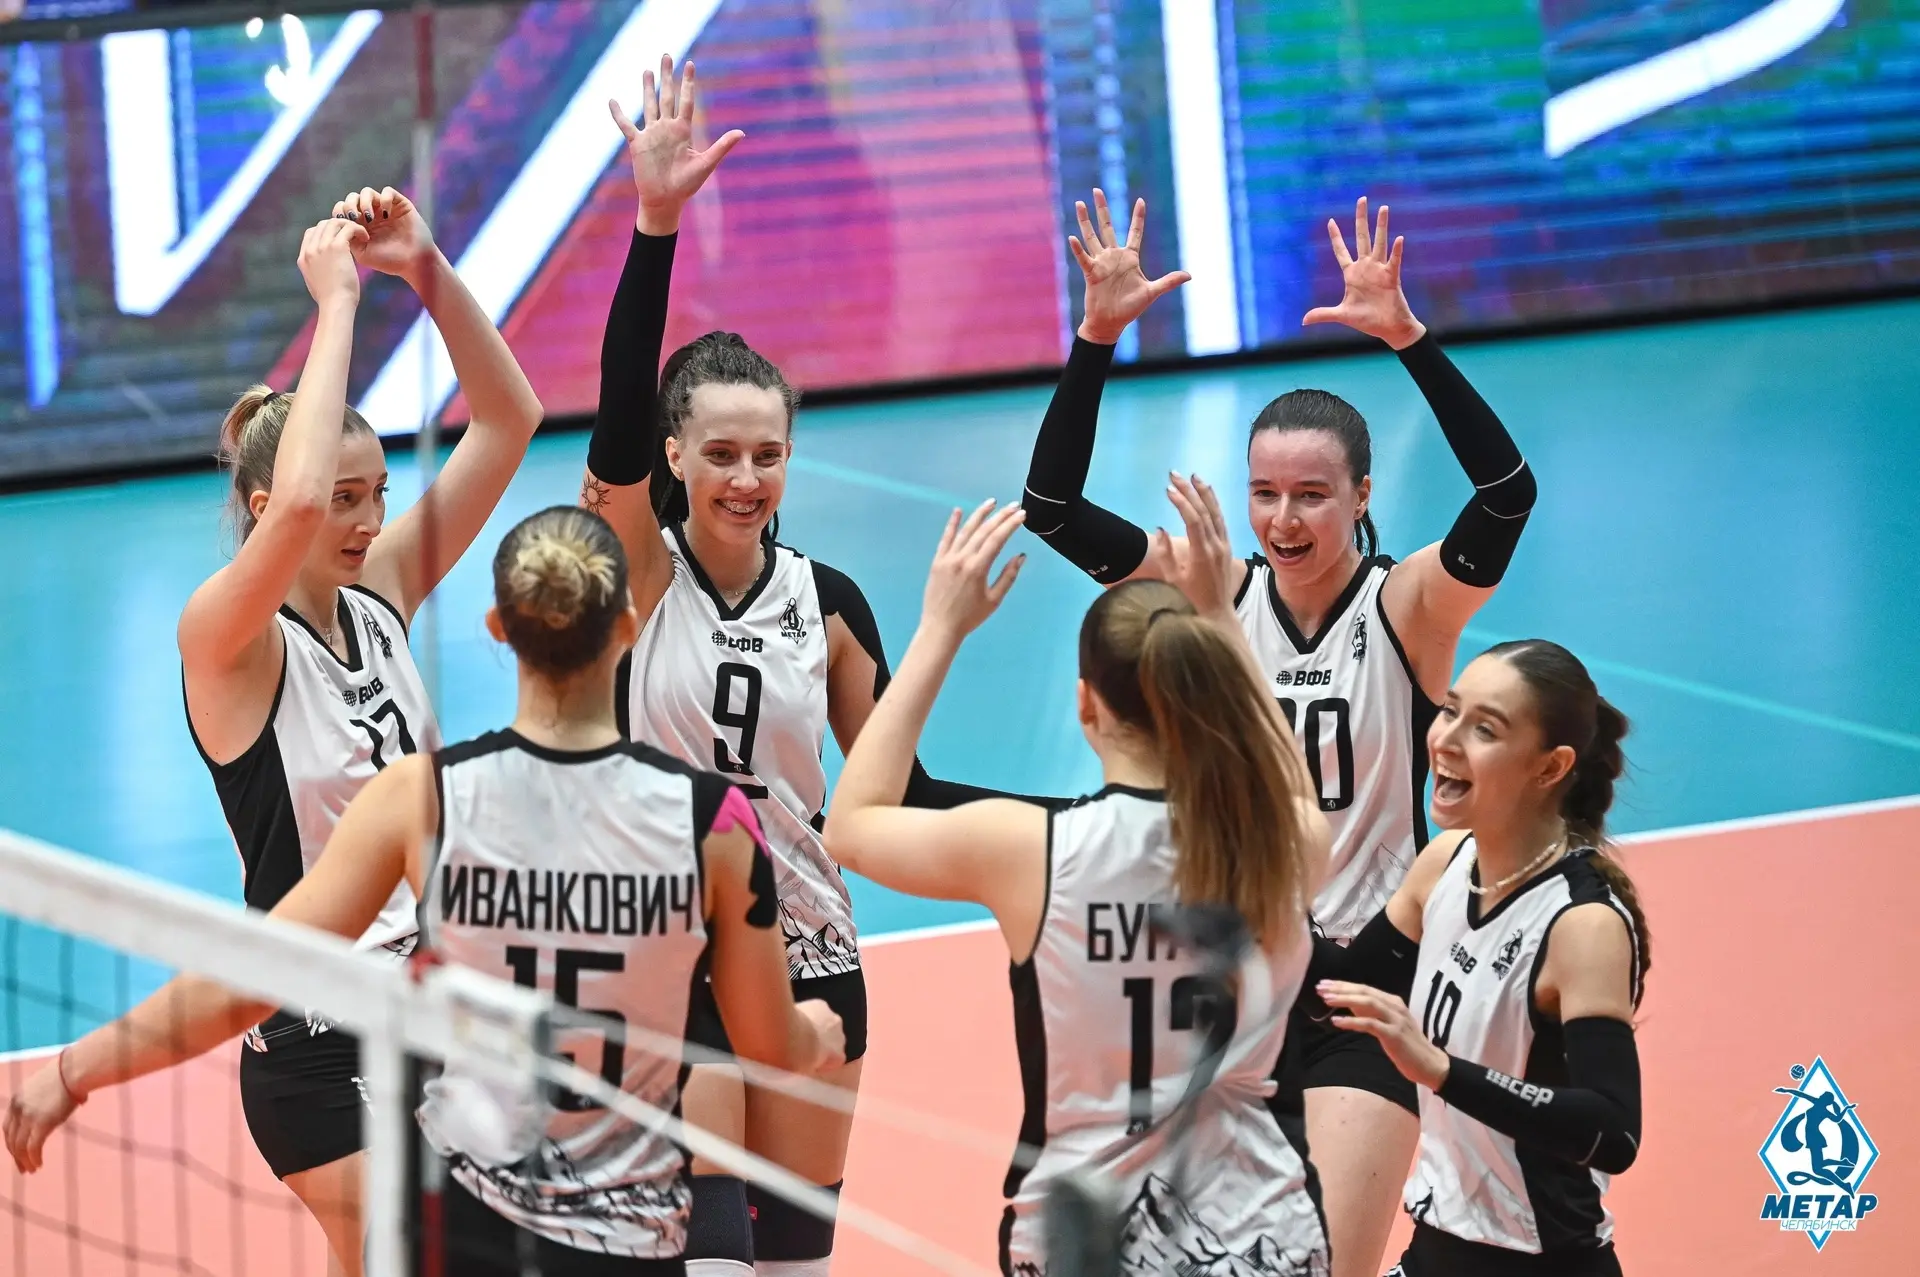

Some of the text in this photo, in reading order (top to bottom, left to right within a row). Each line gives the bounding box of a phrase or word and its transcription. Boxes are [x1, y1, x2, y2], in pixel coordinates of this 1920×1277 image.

[712, 662, 762, 776] 9
[1293, 669, 1332, 686] ВФВ
[1275, 698, 1354, 812] 0
[441, 864, 695, 936] ИВАНКОВИЧ
